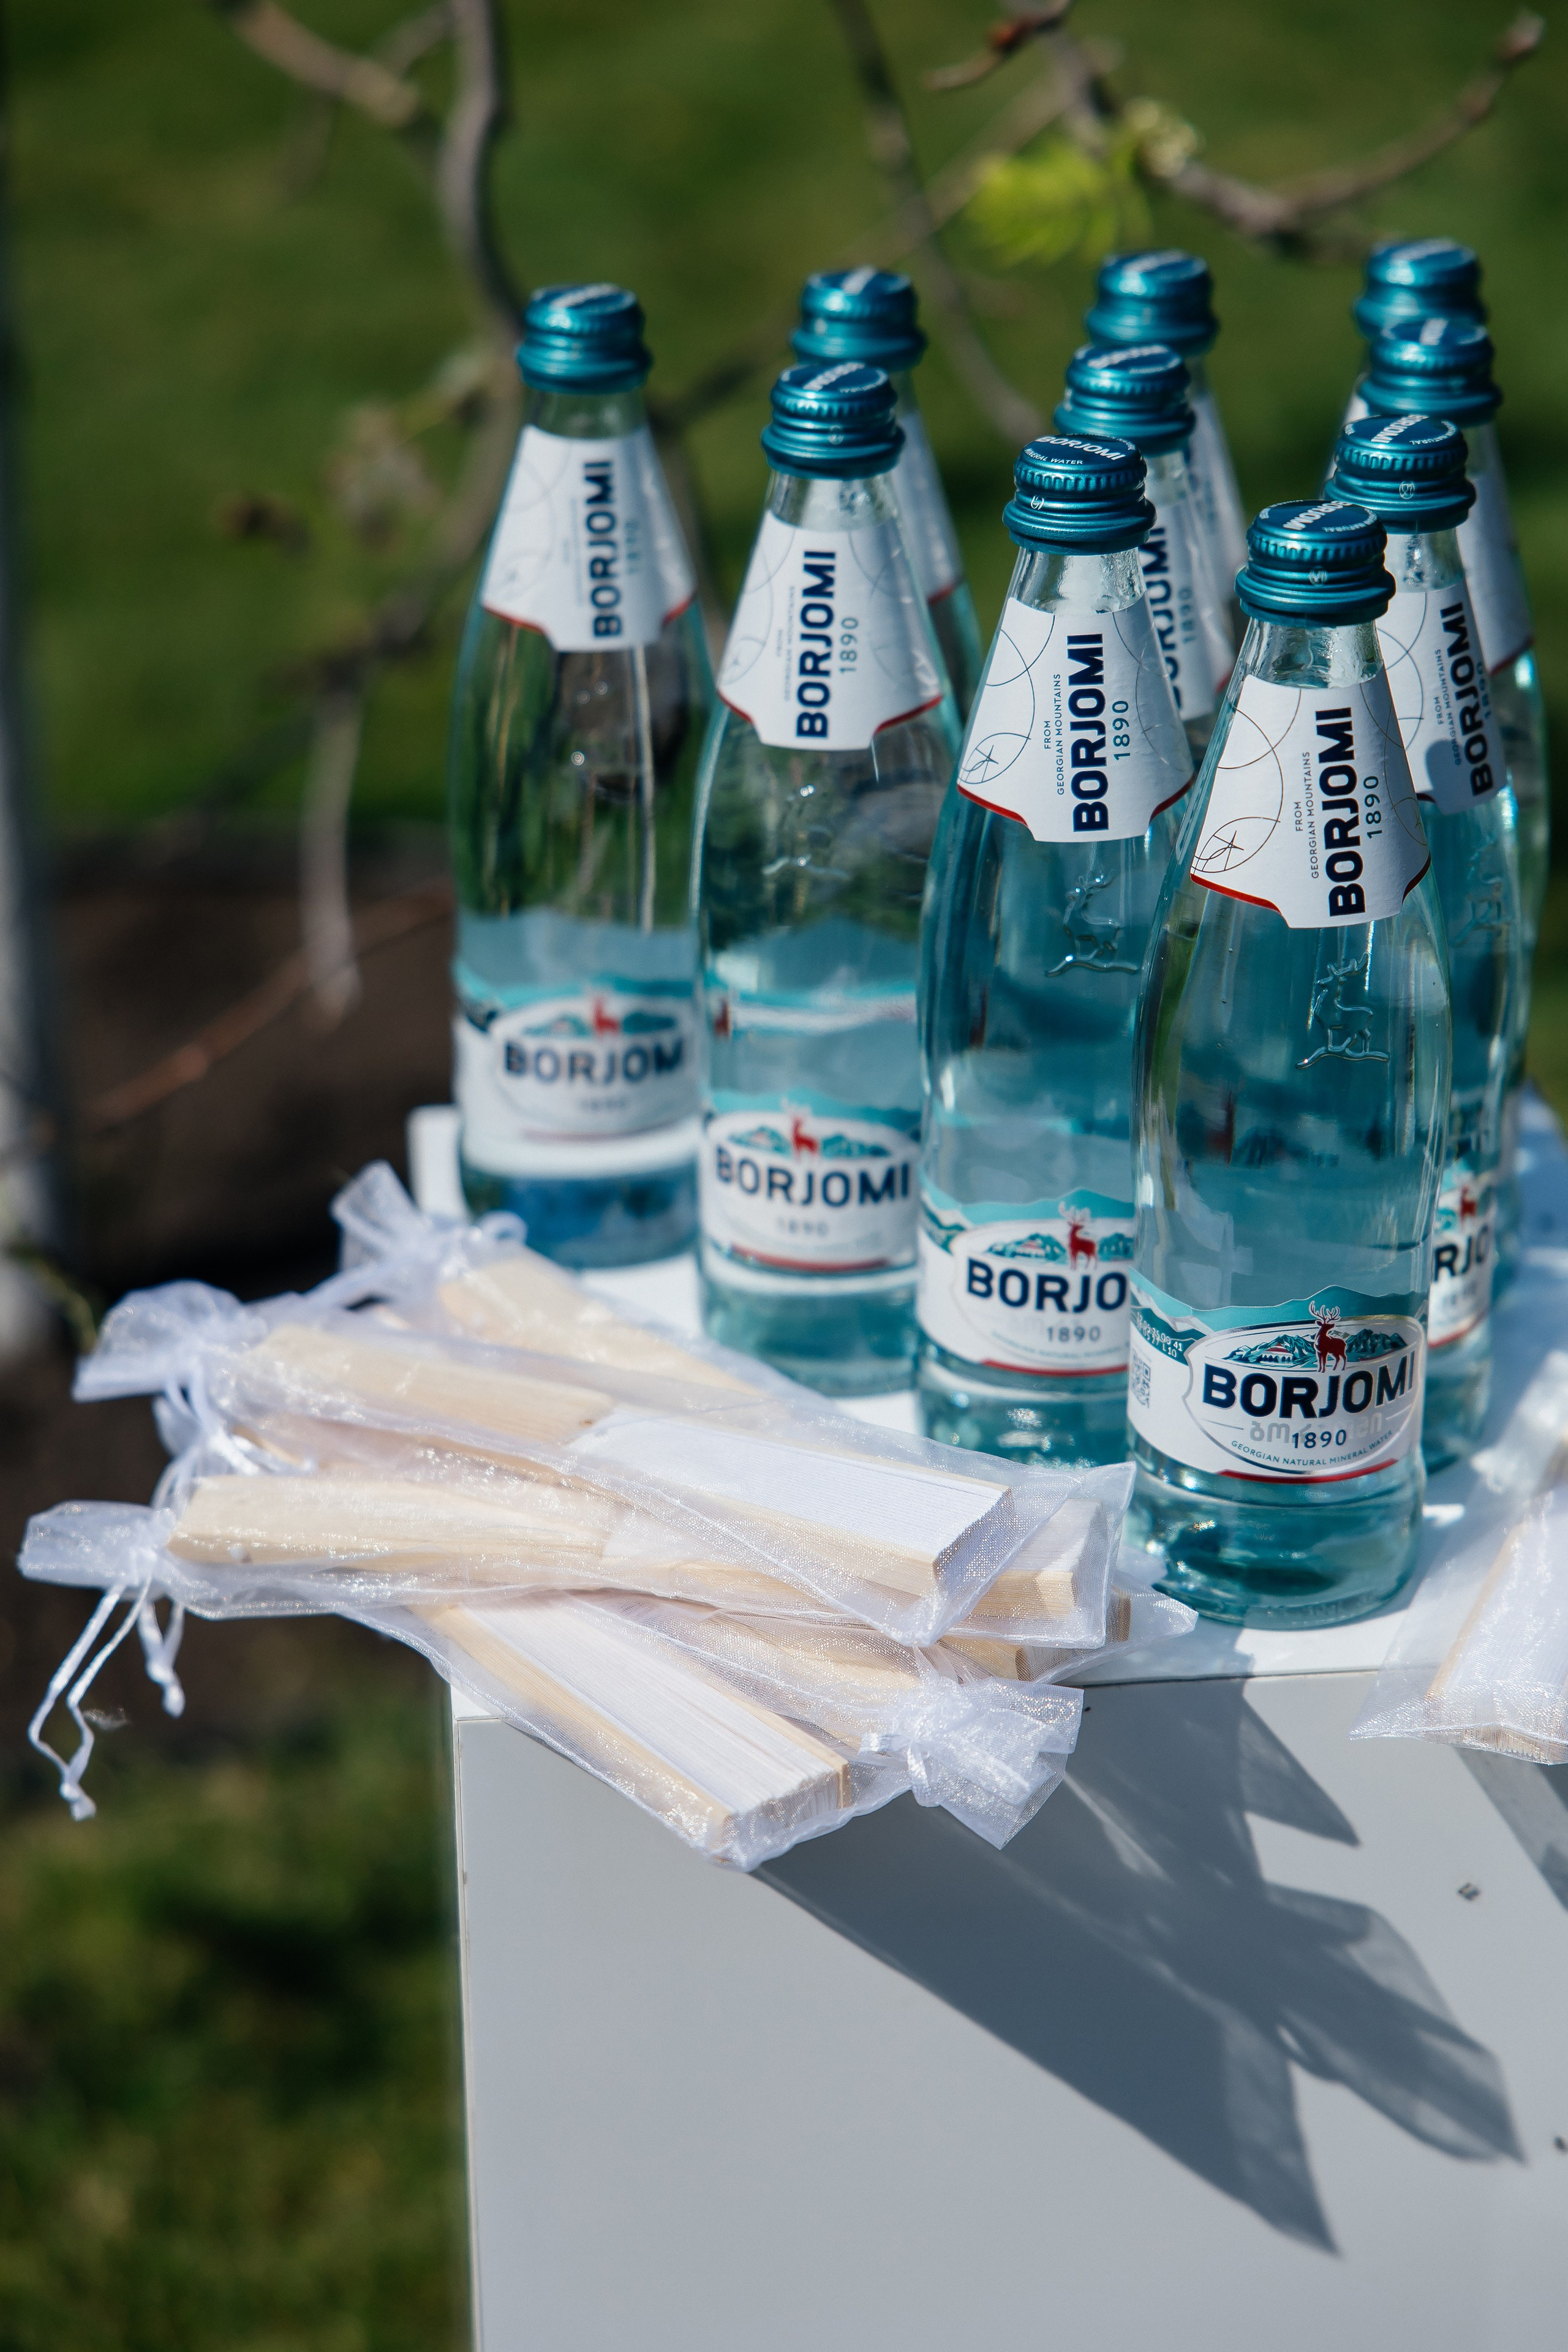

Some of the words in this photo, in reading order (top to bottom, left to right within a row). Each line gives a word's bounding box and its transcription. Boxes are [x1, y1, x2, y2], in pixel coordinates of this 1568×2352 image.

[1024, 448, 1048, 462] MINERAL
[1035, 436, 1126, 461] BORJOMI
[584, 461, 622, 638] BORJOMI
[796, 551, 835, 737] BORJOMI
[839, 617, 859, 674] 1890
[1054, 674, 1063, 736] MOUNTAINS
[1434, 649, 1451, 709] MOUNTAINS
[1440, 602, 1494, 797] BORJOMI
[1067, 633, 1109, 832] BORJOMI
[1112, 700, 1131, 761] 1890
[1433, 696, 1444, 725] FROM
[1446, 712, 1461, 766] GEORGIAN
[1055, 739, 1065, 796] GEORGIAN
[1302, 752, 1314, 816] MOUNTAINS
[1294, 801, 1303, 831] FROM
[1315, 707, 1366, 917] BORJOMI
[1363, 775, 1382, 839] 1890
[1306, 821, 1319, 879] GEORGIAN
[716, 1144, 909, 1207] BORJOMI
[1048, 1326, 1101, 1343] 1890
[1167, 1347, 1177, 1358] 10
[1173, 1341, 1183, 1352] 41
[1203, 1349, 1415, 1419] BORJOMI
[1231, 1440, 1280, 1463] GEORGIAN
[1283, 1457, 1327, 1466] NATURAL
[1329, 1447, 1367, 1464] MINERAL
[1368, 1430, 1393, 1450] WATER
[1292, 1429, 1348, 1449] 1890
